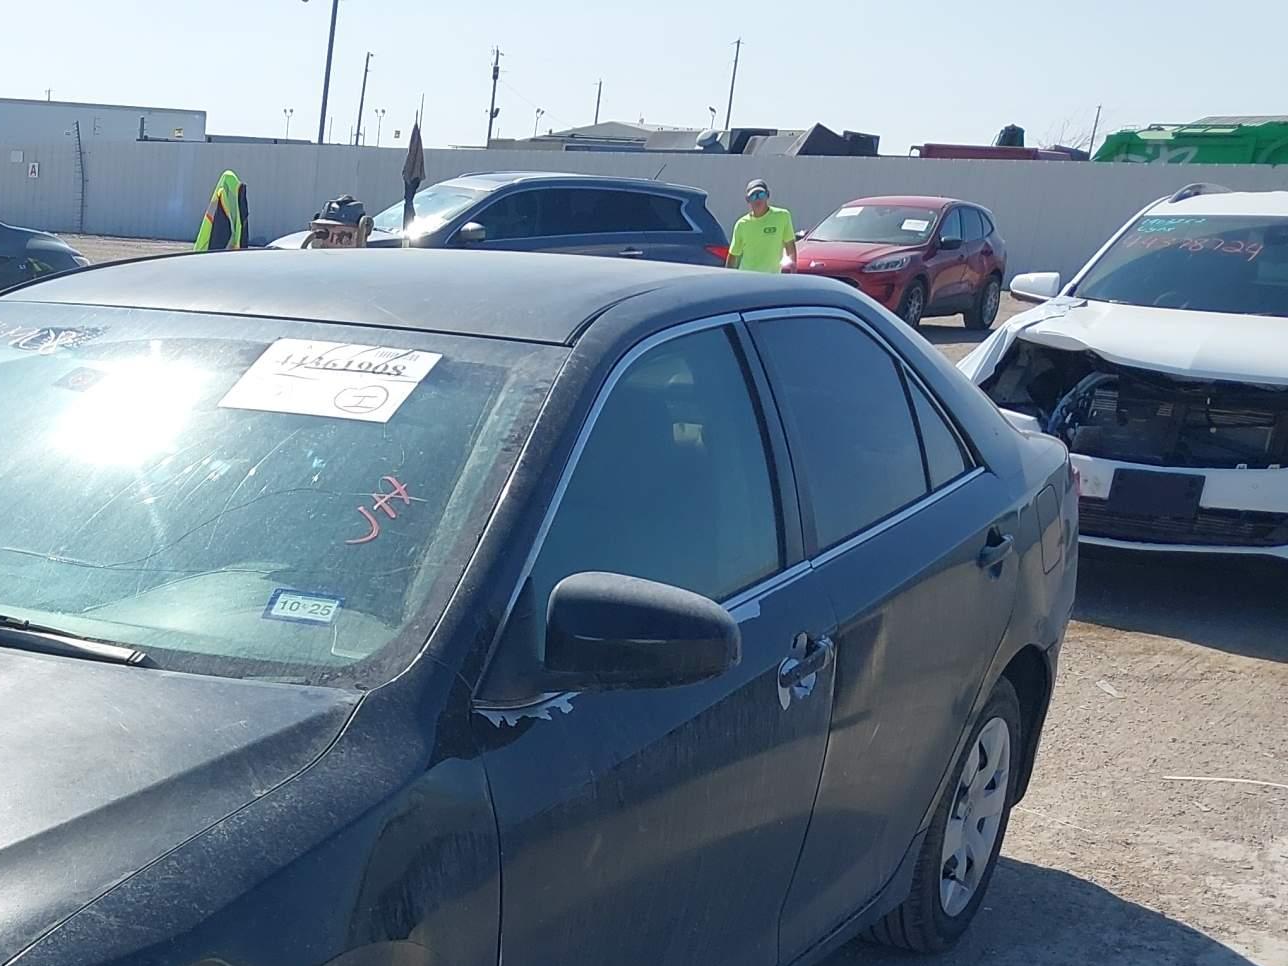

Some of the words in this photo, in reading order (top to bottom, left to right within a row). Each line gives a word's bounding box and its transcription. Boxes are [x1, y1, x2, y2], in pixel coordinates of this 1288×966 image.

[29, 164, 37, 177] A
[280, 600, 301, 612] 10
[308, 603, 333, 617] 25
